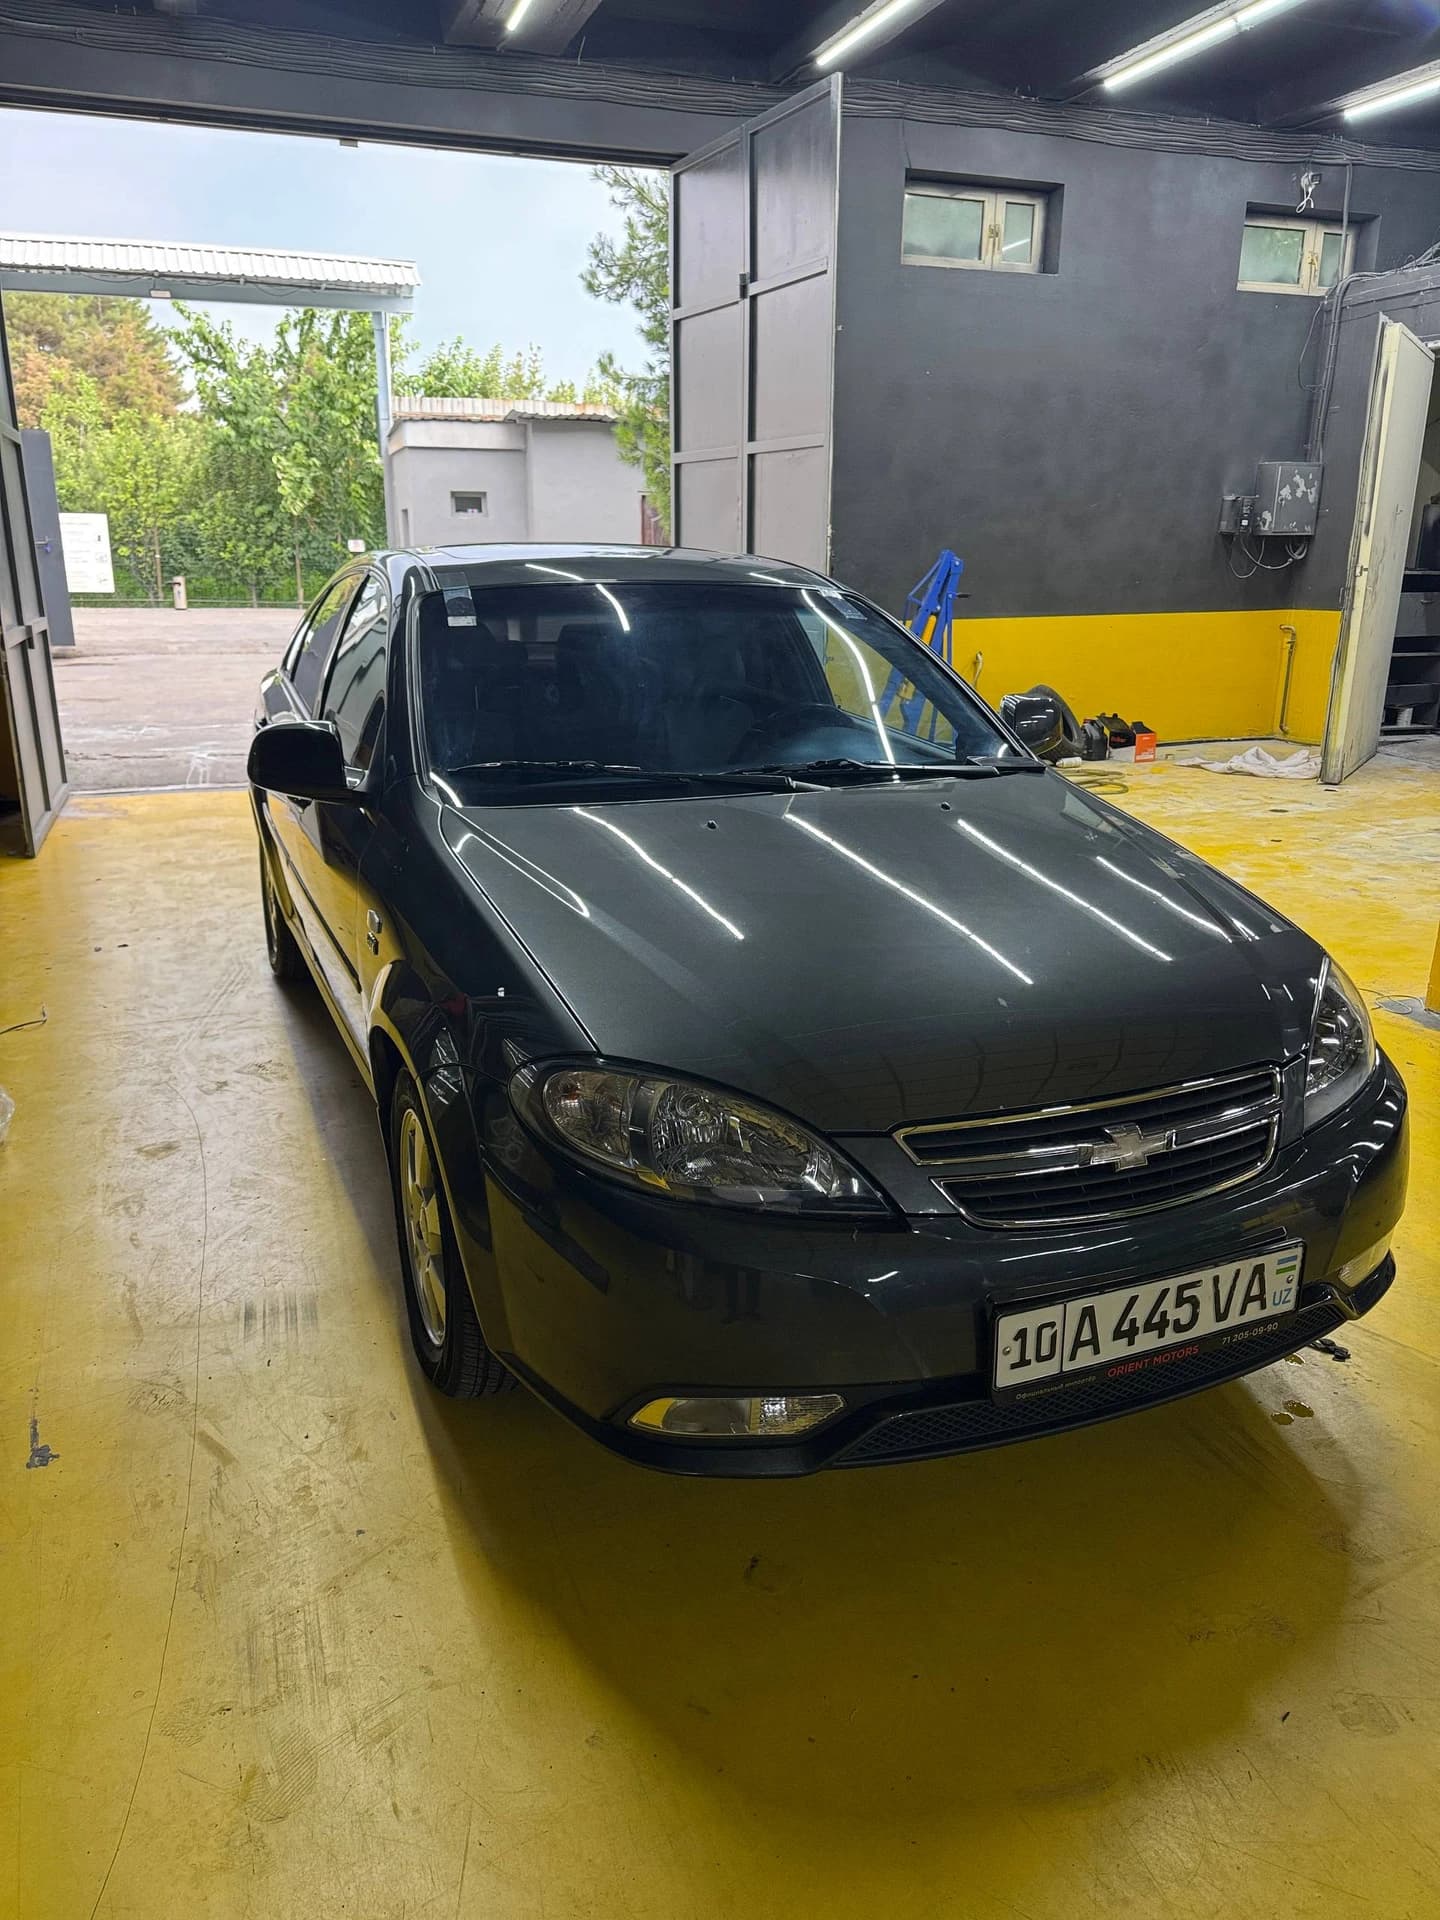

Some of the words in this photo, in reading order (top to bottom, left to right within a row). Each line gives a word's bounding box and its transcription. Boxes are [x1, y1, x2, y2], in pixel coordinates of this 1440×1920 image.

[1272, 1288, 1292, 1307] UZ
[1010, 1321, 1057, 1369] 10
[1069, 1305, 1101, 1361] A
[1112, 1280, 1202, 1346] 445
[1213, 1263, 1267, 1322] VA
[1233, 1322, 1279, 1342] 205-09-90
[1107, 1359, 1150, 1378] ORIENT
[1152, 1345, 1200, 1365] MOTORS
